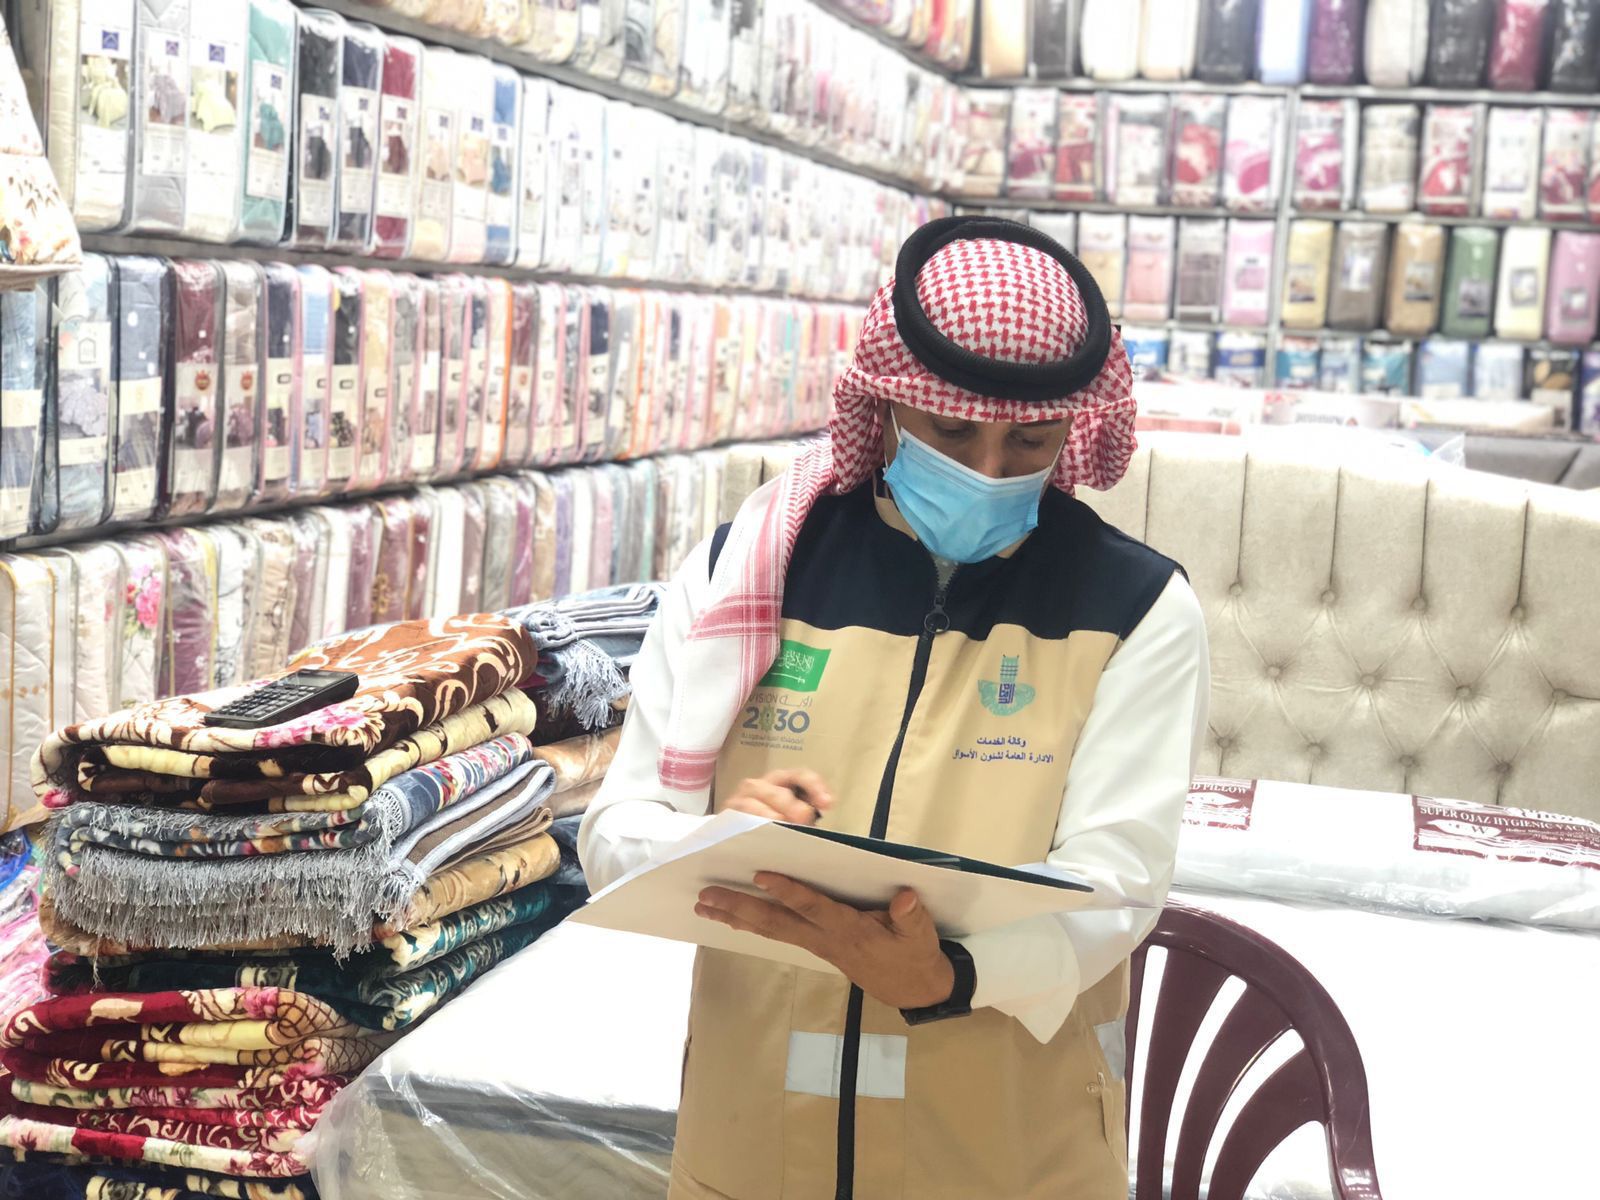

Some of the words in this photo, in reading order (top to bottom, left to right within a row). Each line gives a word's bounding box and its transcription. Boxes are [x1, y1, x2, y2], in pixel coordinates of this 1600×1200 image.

[742, 705, 810, 734] 2030
[976, 736, 1005, 746] الخدمات
[1008, 735, 1026, 748] وكالة
[1006, 750, 1026, 760] العامة
[1203, 783, 1247, 793] PILLOW
[1420, 806, 1458, 818] SUPER
[1460, 812, 1491, 825] OJAZ
[1494, 817, 1552, 830] HYGIENIC
